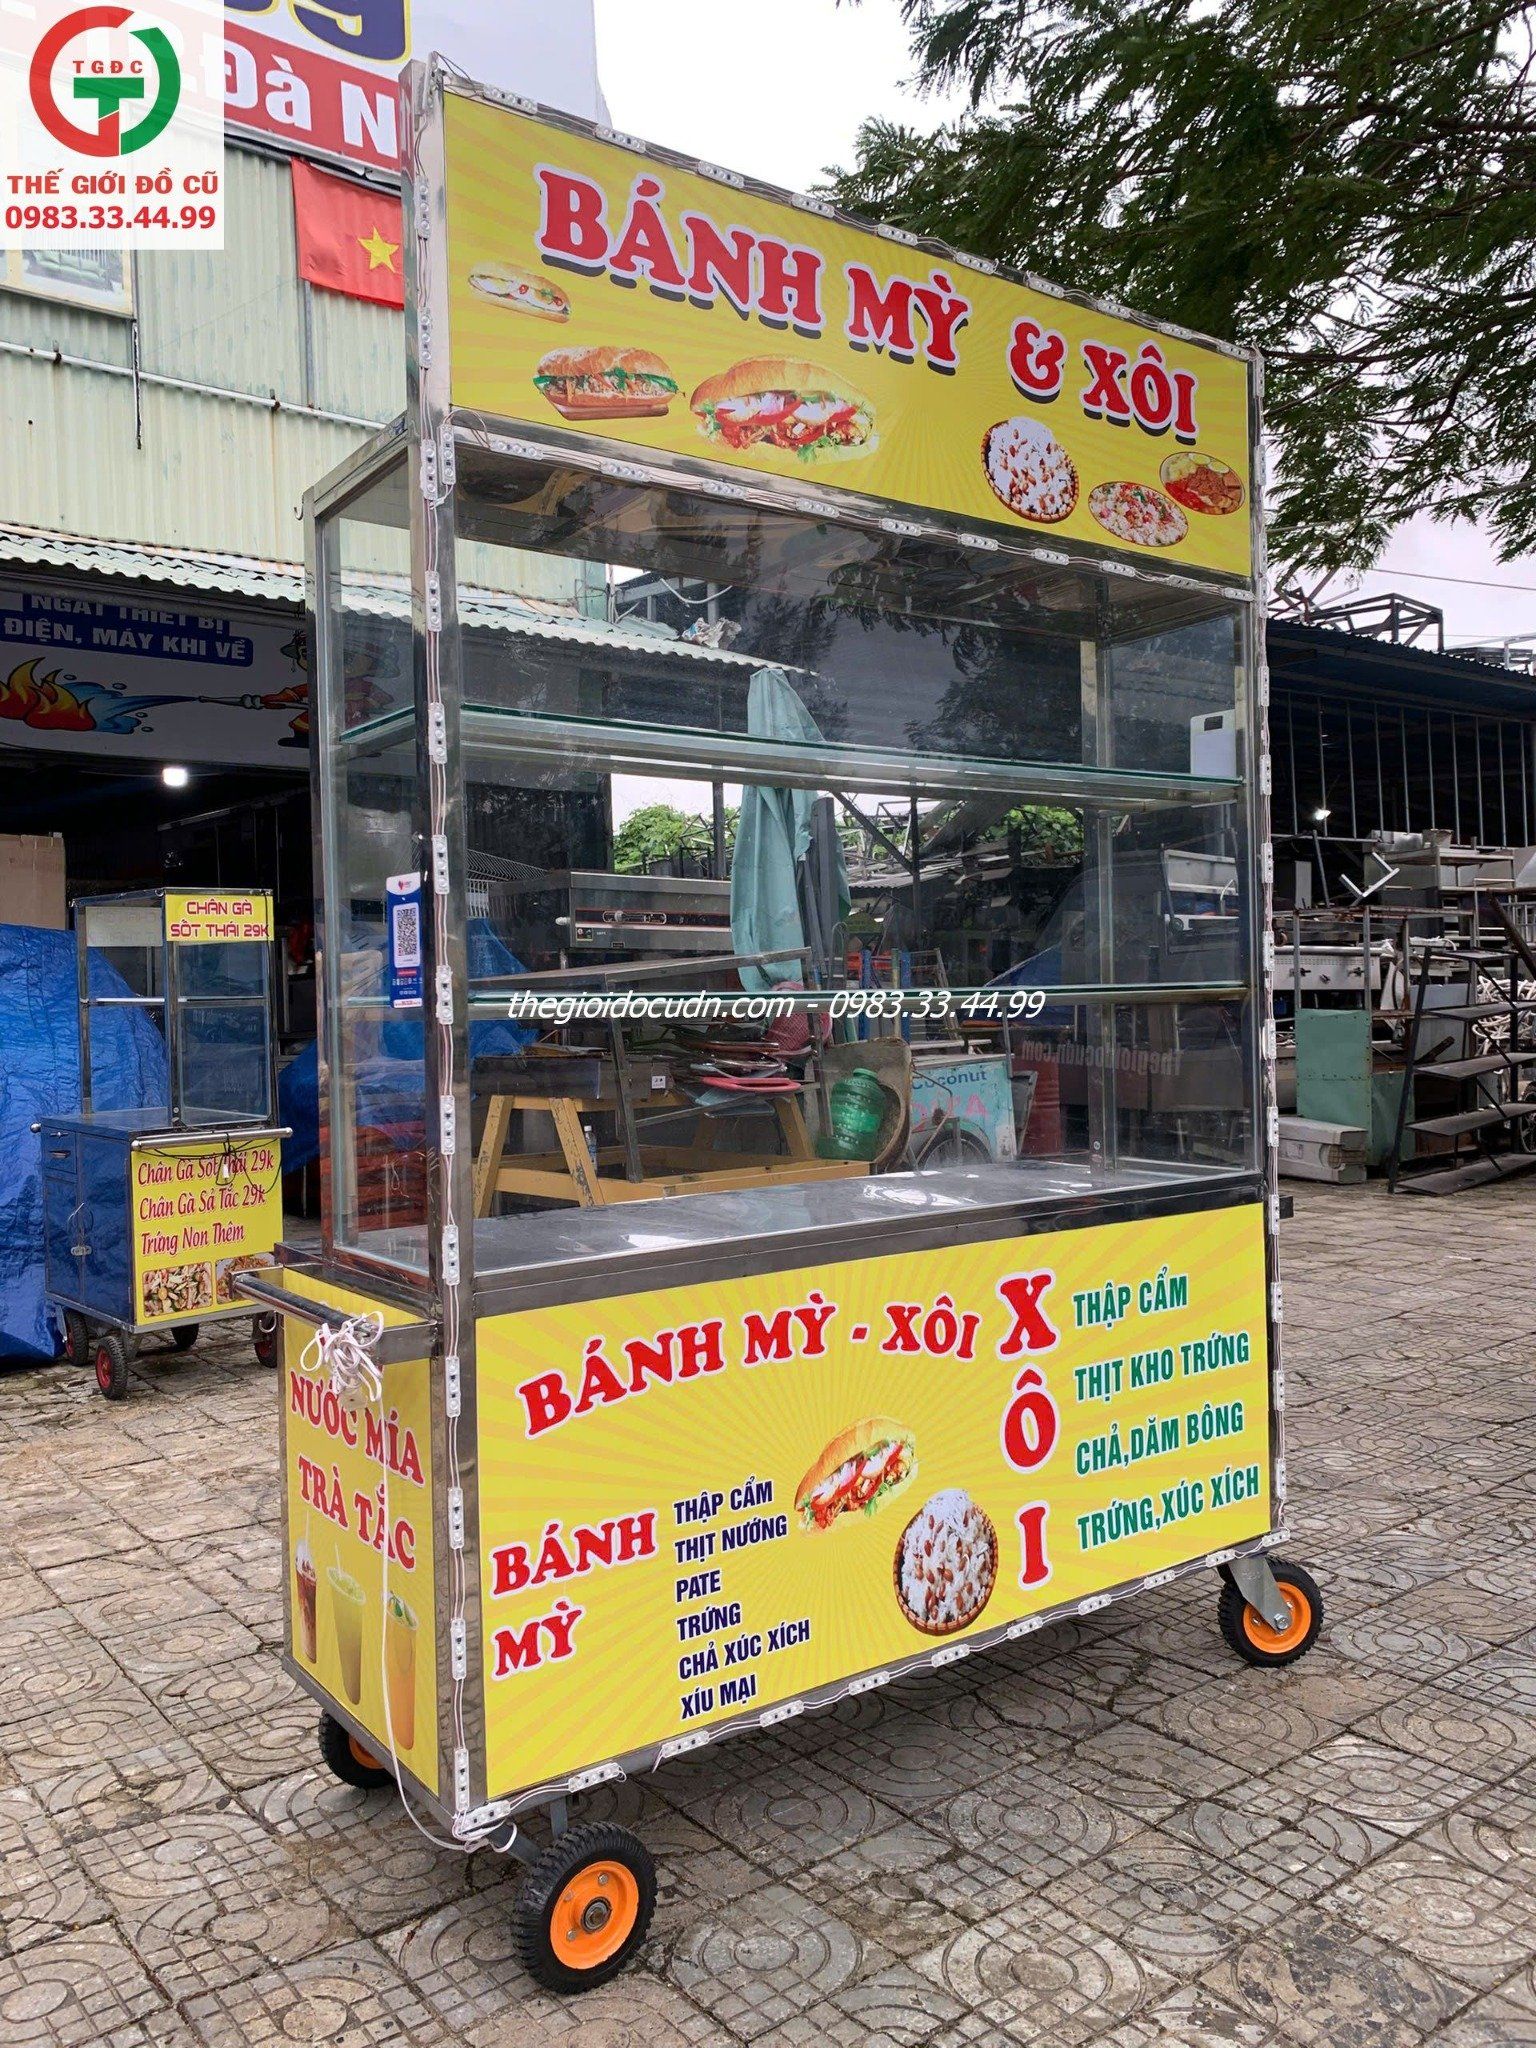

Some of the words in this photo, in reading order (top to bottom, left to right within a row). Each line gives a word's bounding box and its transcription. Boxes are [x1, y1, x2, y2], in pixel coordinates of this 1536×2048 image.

[536, 167, 824, 334] BÁNH
[845, 264, 970, 370] MỲ
[1009, 320, 1065, 398] &
[1082, 343, 1197, 440] XÔI
[93, 627, 153, 650] MÁY
[162, 635, 206, 656] KHI
[170, 919, 201, 937] SỐT
[206, 921, 239, 937] THÁI
[244, 924, 270, 937] 29K
[187, 899, 228, 914] CHÂN
[233, 900, 252, 915] GÀ
[138, 1161, 172, 1185] Chân
[250, 1149, 274, 1172] 29k
[139, 1196, 173, 1220] Chân
[178, 1191, 195, 1214] Gà
[219, 1184, 239, 1209] Tắc
[242, 1184, 265, 1207] 29k
[141, 1230, 178, 1256] Trứng
[182, 1227, 207, 1249] Non
[212, 1221, 244, 1244] Thêm
[1073, 1282, 1131, 1328] THẬP
[1139, 1266, 1188, 1314] CẨM
[518, 1318, 725, 1437] BÁNH
[743, 1293, 836, 1364] MỲ
[881, 1294, 980, 1359] XÔI
[1074, 1358, 1123, 1401] THỊT
[1131, 1349, 1174, 1388] KHO
[1181, 1332, 1250, 1375] TRỨNG
[1187, 1401, 1244, 1437] BÔNG
[365, 1407, 424, 1485] MÍA
[673, 1491, 724, 1524] THẬP
[730, 1475, 773, 1511] CẨM
[1211, 1466, 1259, 1507] XÍCH
[298, 1455, 349, 1530] TRÀ
[354, 1482, 416, 1570] TẮC
[492, 1512, 656, 1596] BÁNH
[674, 1536, 715, 1563] THỊT
[722, 1514, 788, 1549] NƯỚNG
[676, 1570, 721, 1602] PATE
[494, 1601, 583, 1677] MỲ
[677, 1602, 741, 1641] TRỨNG
[679, 1642, 719, 1680] CHẢ
[724, 1634, 762, 1667] XÚC
[768, 1619, 811, 1653] XÍCH
[681, 1687, 713, 1719] XÍU
[721, 1675, 757, 1707] MẠI
